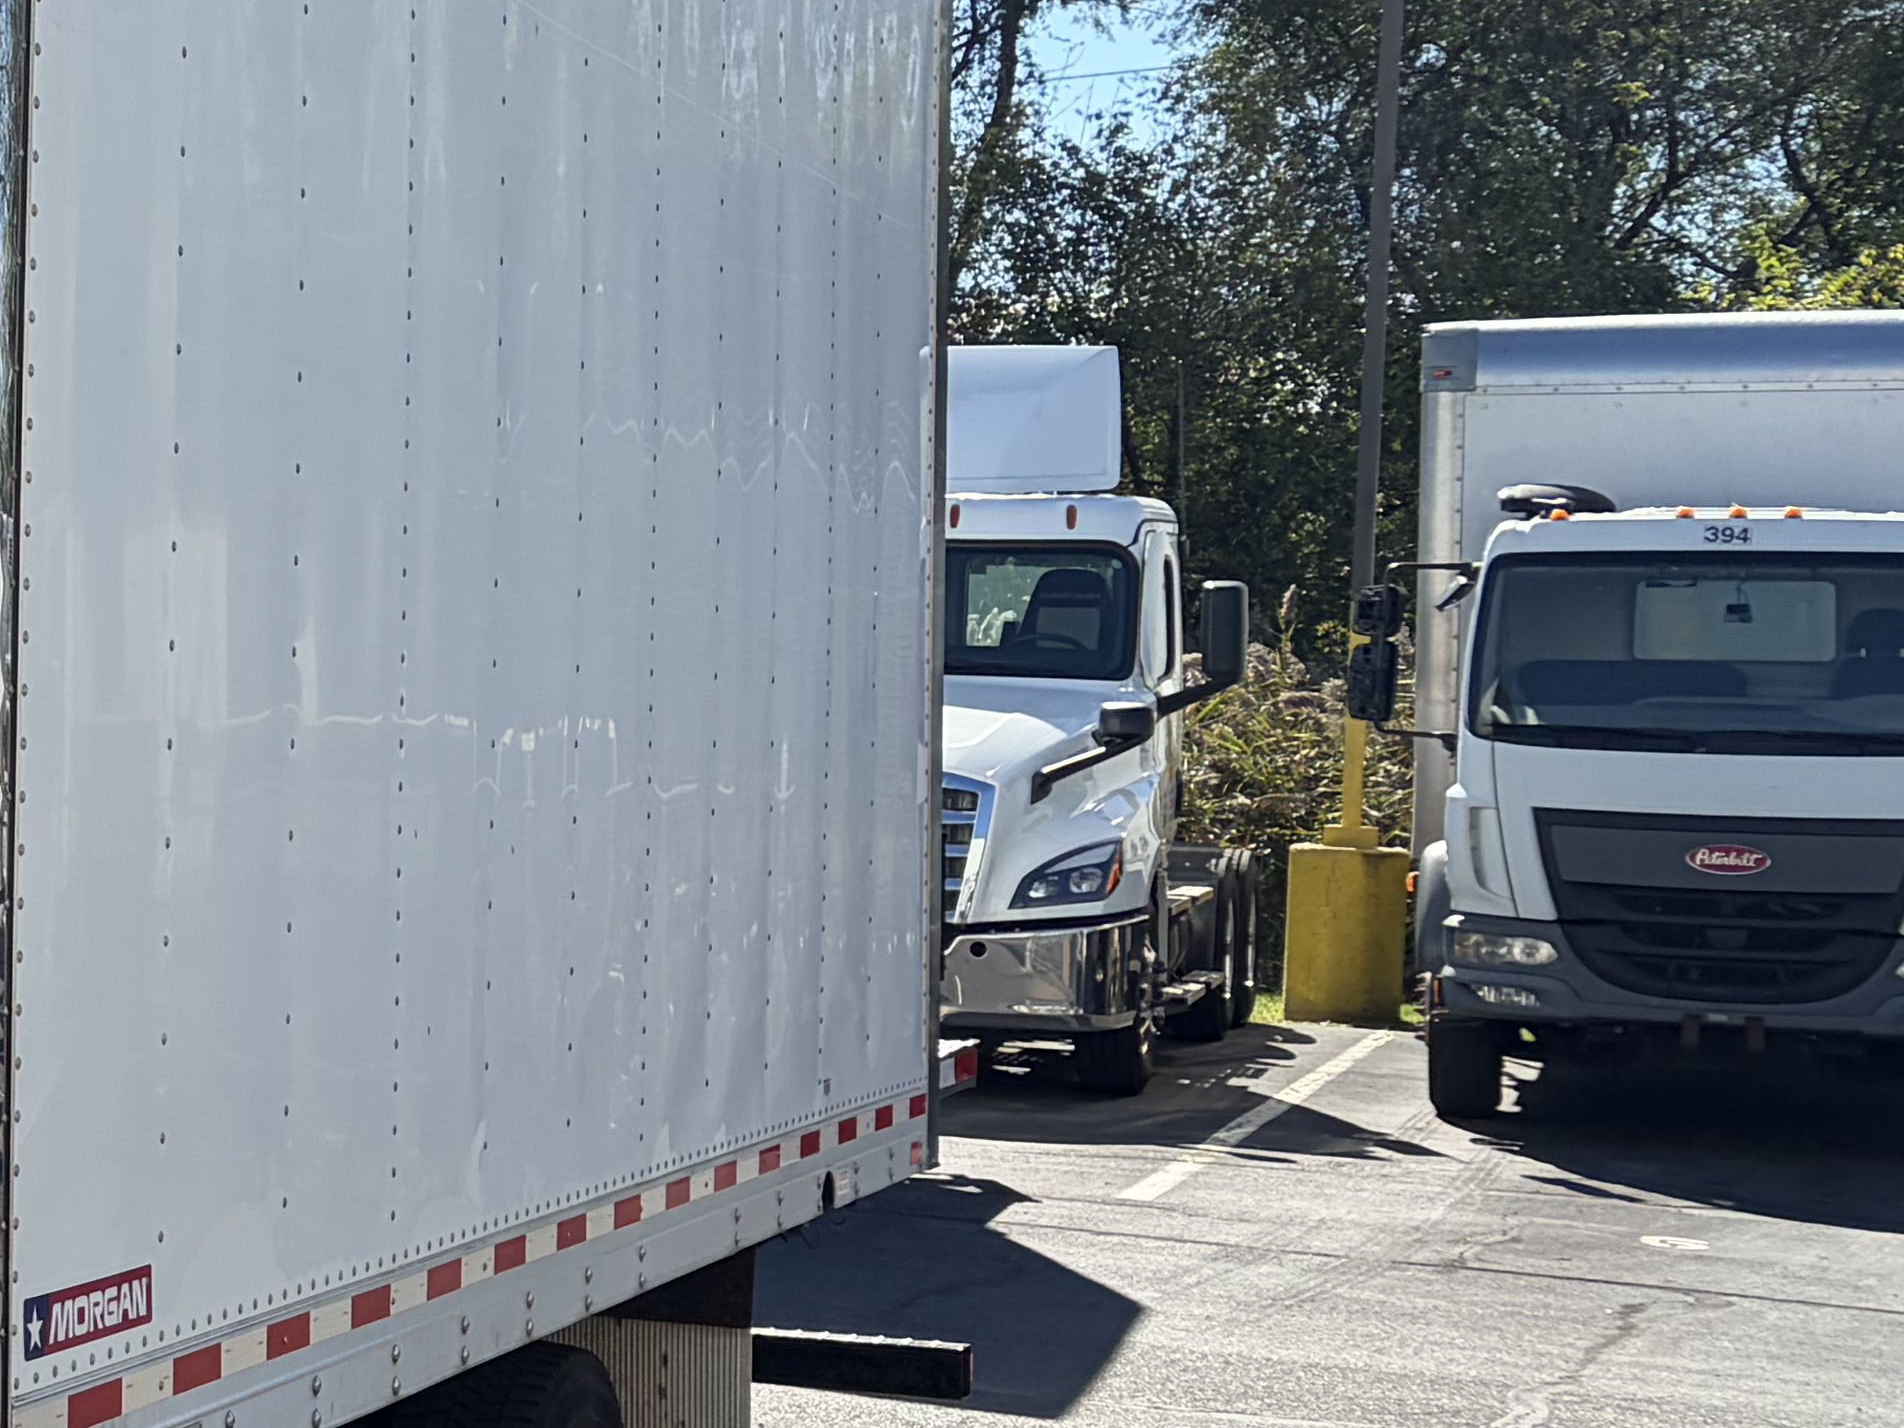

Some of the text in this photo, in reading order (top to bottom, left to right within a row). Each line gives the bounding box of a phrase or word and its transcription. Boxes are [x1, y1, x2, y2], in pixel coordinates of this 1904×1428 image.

[1703, 525, 1751, 544] 394
[1695, 848, 1763, 867] Peterbilt
[49, 1276, 149, 1345] MORGAN
